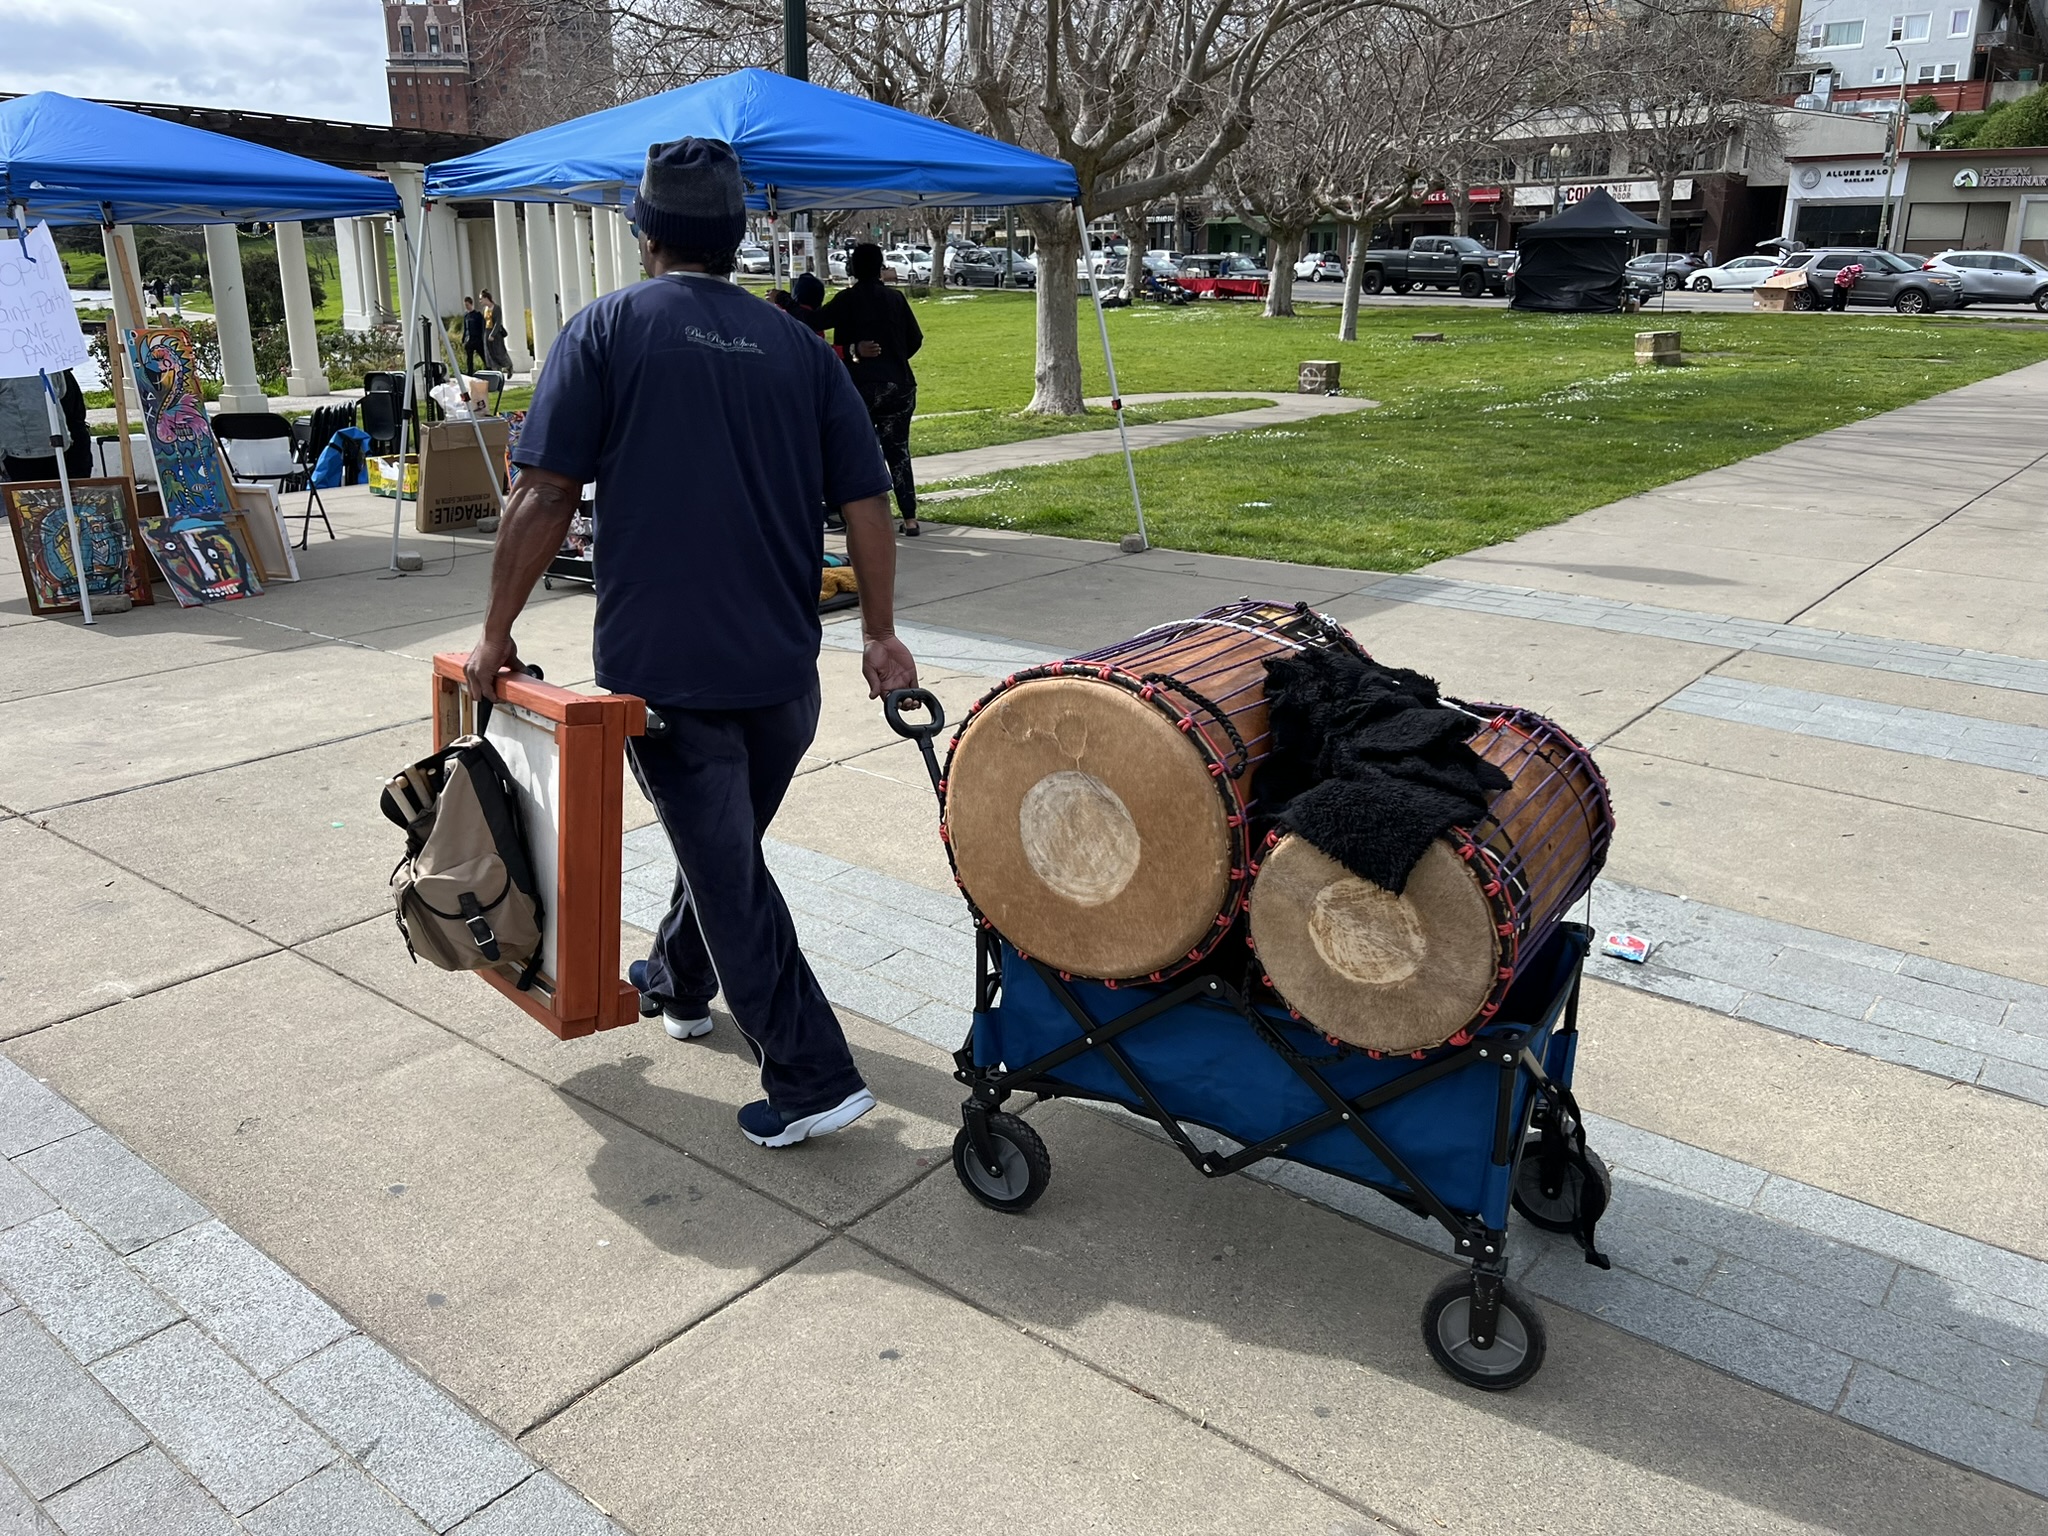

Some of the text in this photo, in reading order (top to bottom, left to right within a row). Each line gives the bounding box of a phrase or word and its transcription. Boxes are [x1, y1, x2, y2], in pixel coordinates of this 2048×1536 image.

[1826, 168, 1895, 178] ALLURE SALO
[1982, 168, 2008, 176] EAST
[1980, 175, 2048, 187] VETERINAR
[1612, 184, 1632, 192] NEXT
[0, 295, 31, 323] aint
[22, 328, 66, 365] PAINT!
[733, 336, 758, 348] Sports
